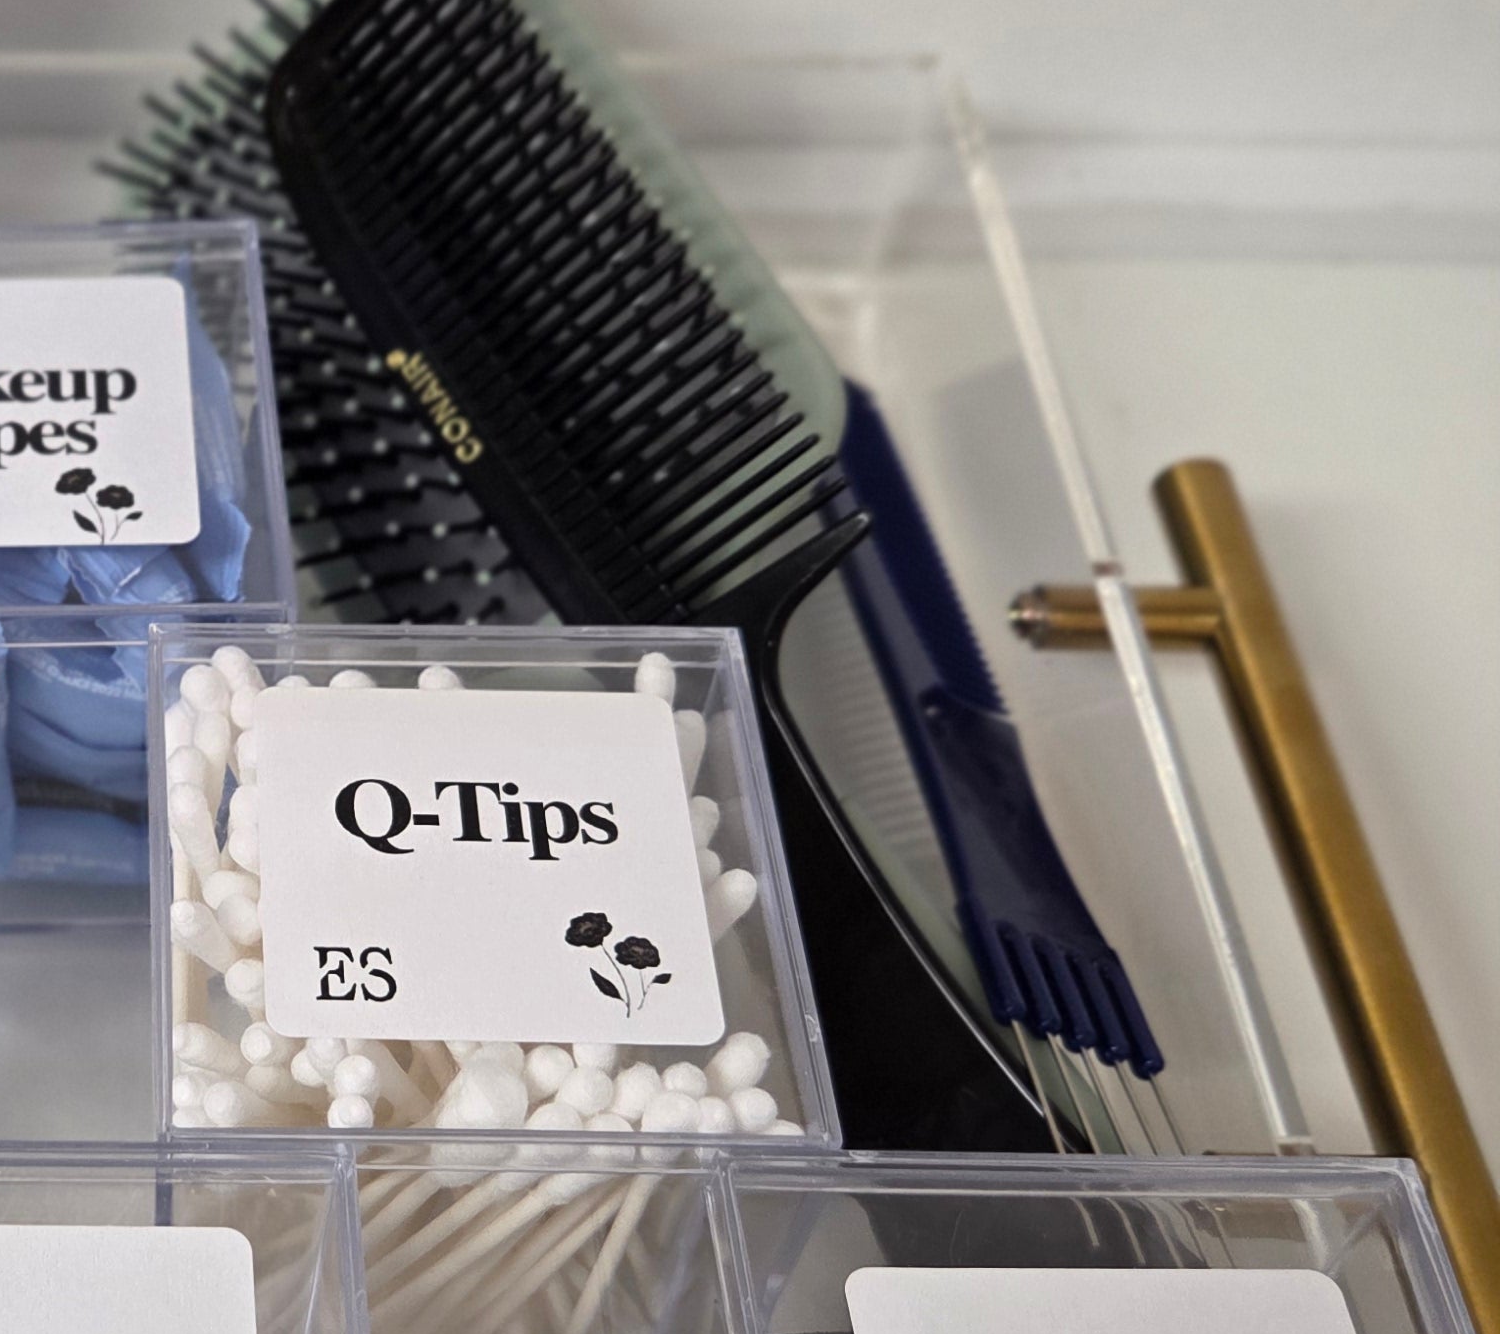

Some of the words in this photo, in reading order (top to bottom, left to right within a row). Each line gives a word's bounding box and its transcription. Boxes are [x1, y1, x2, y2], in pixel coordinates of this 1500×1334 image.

[402, 352, 483, 463] CONAIR
[334, 778, 619, 861] Q-Tips
[313, 946, 397, 1002] ES
